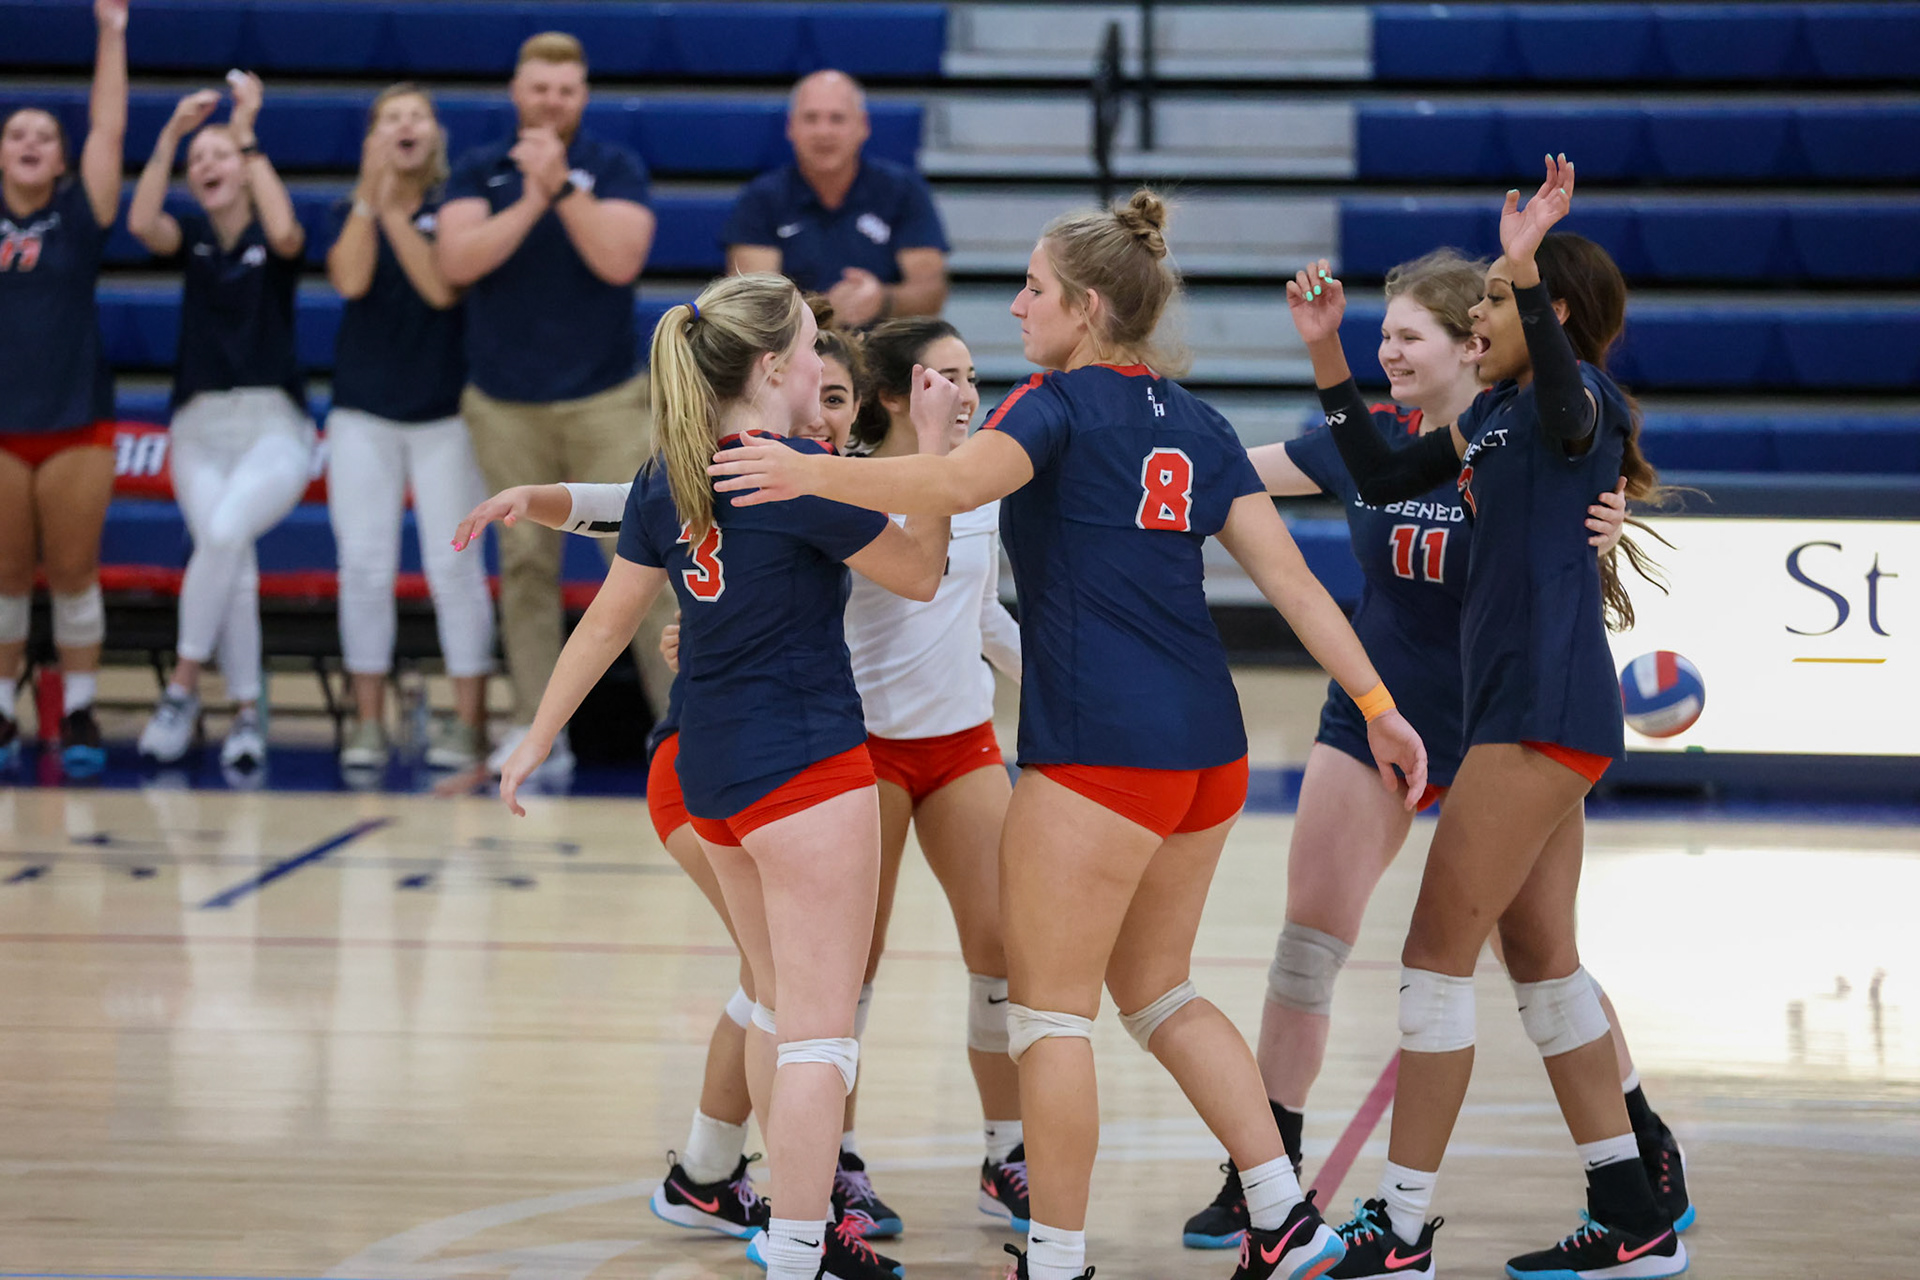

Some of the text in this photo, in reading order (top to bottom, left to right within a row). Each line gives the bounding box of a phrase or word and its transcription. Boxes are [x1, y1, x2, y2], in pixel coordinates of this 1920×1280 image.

[1135, 446, 1194, 532] 8
[675, 518, 726, 603] 3
[1388, 524, 1450, 584] 11
[1785, 540, 1898, 636] St
